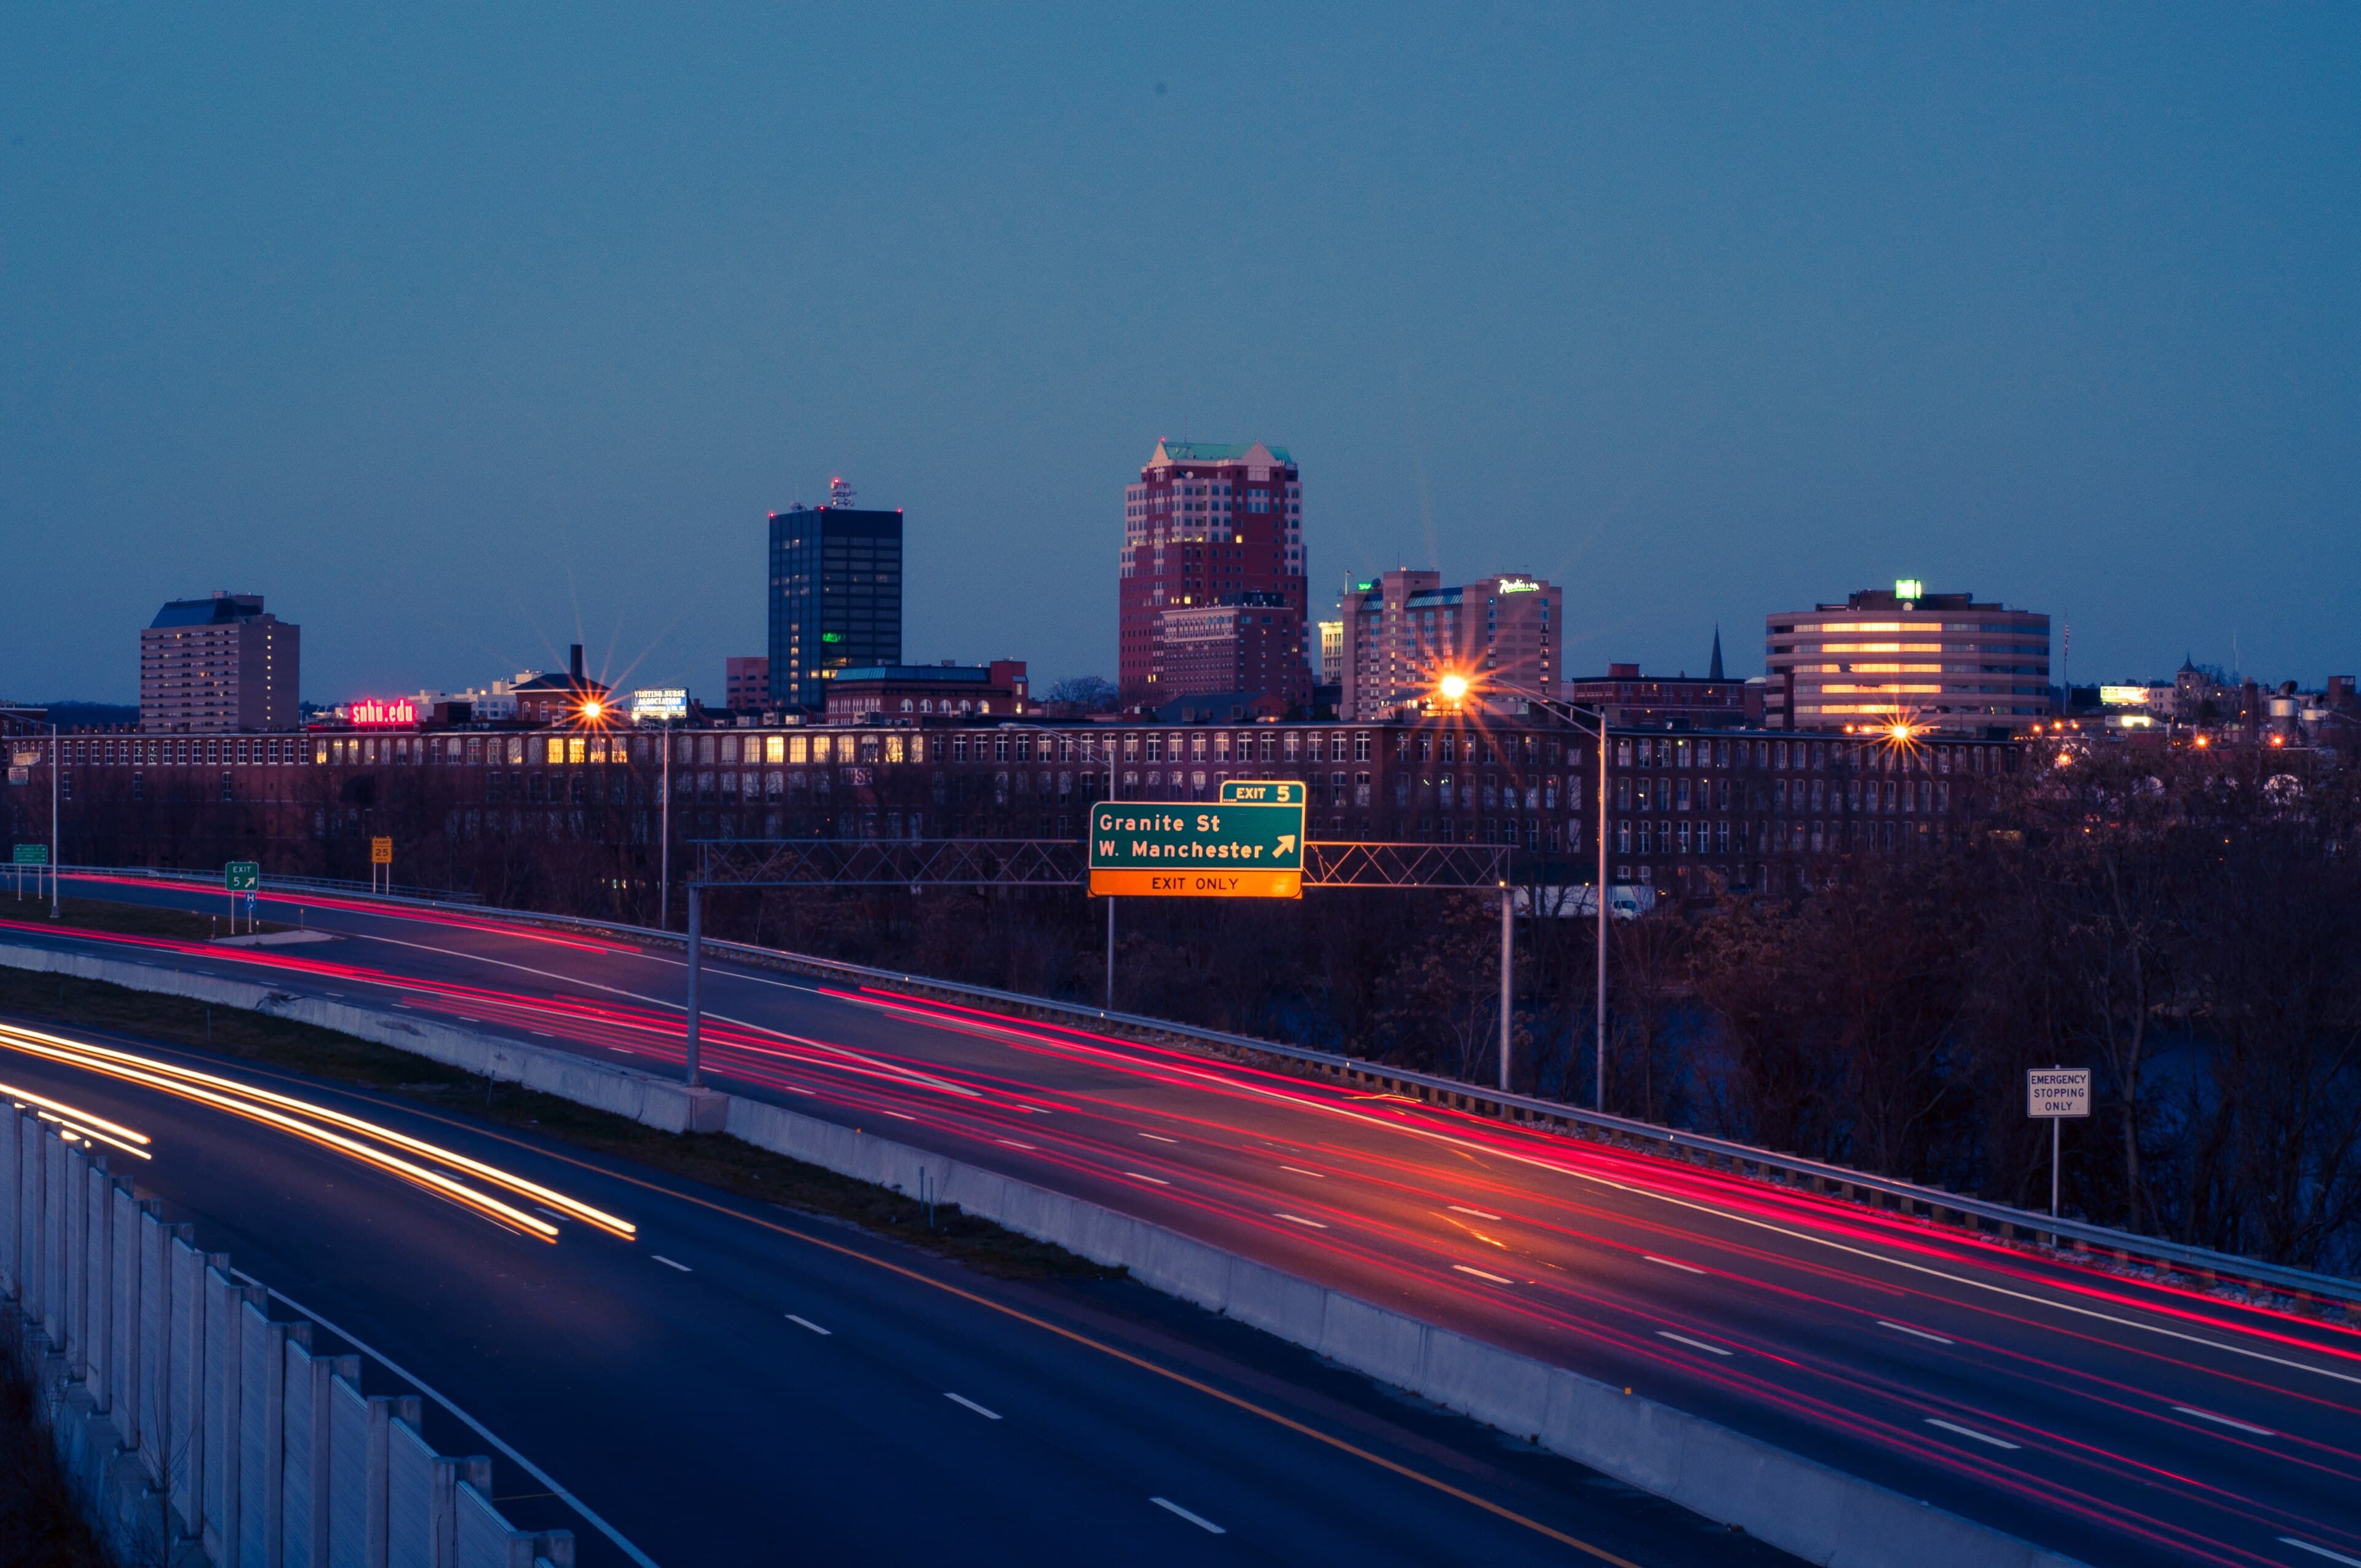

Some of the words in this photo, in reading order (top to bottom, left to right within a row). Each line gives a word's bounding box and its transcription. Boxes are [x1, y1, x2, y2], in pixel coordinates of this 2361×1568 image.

[353, 699, 413, 722] snhu.edu
[1236, 787, 1266, 799] EXIT
[1277, 785, 1290, 802] 5
[1100, 814, 1184, 831] Granite
[1196, 814, 1220, 832] St
[1099, 840, 1119, 857] W.
[1132, 840, 1264, 858] Manchester
[234, 877, 240, 886] 5
[1152, 877, 1185, 890] EXIT
[1196, 877, 1239, 890] ONLY
[247, 893, 255, 902] H
[2031, 1075, 2086, 1084] EMERGENCY
[2034, 1088, 2084, 1098] STOPPING
[2045, 1102, 2072, 1111] ONLY
